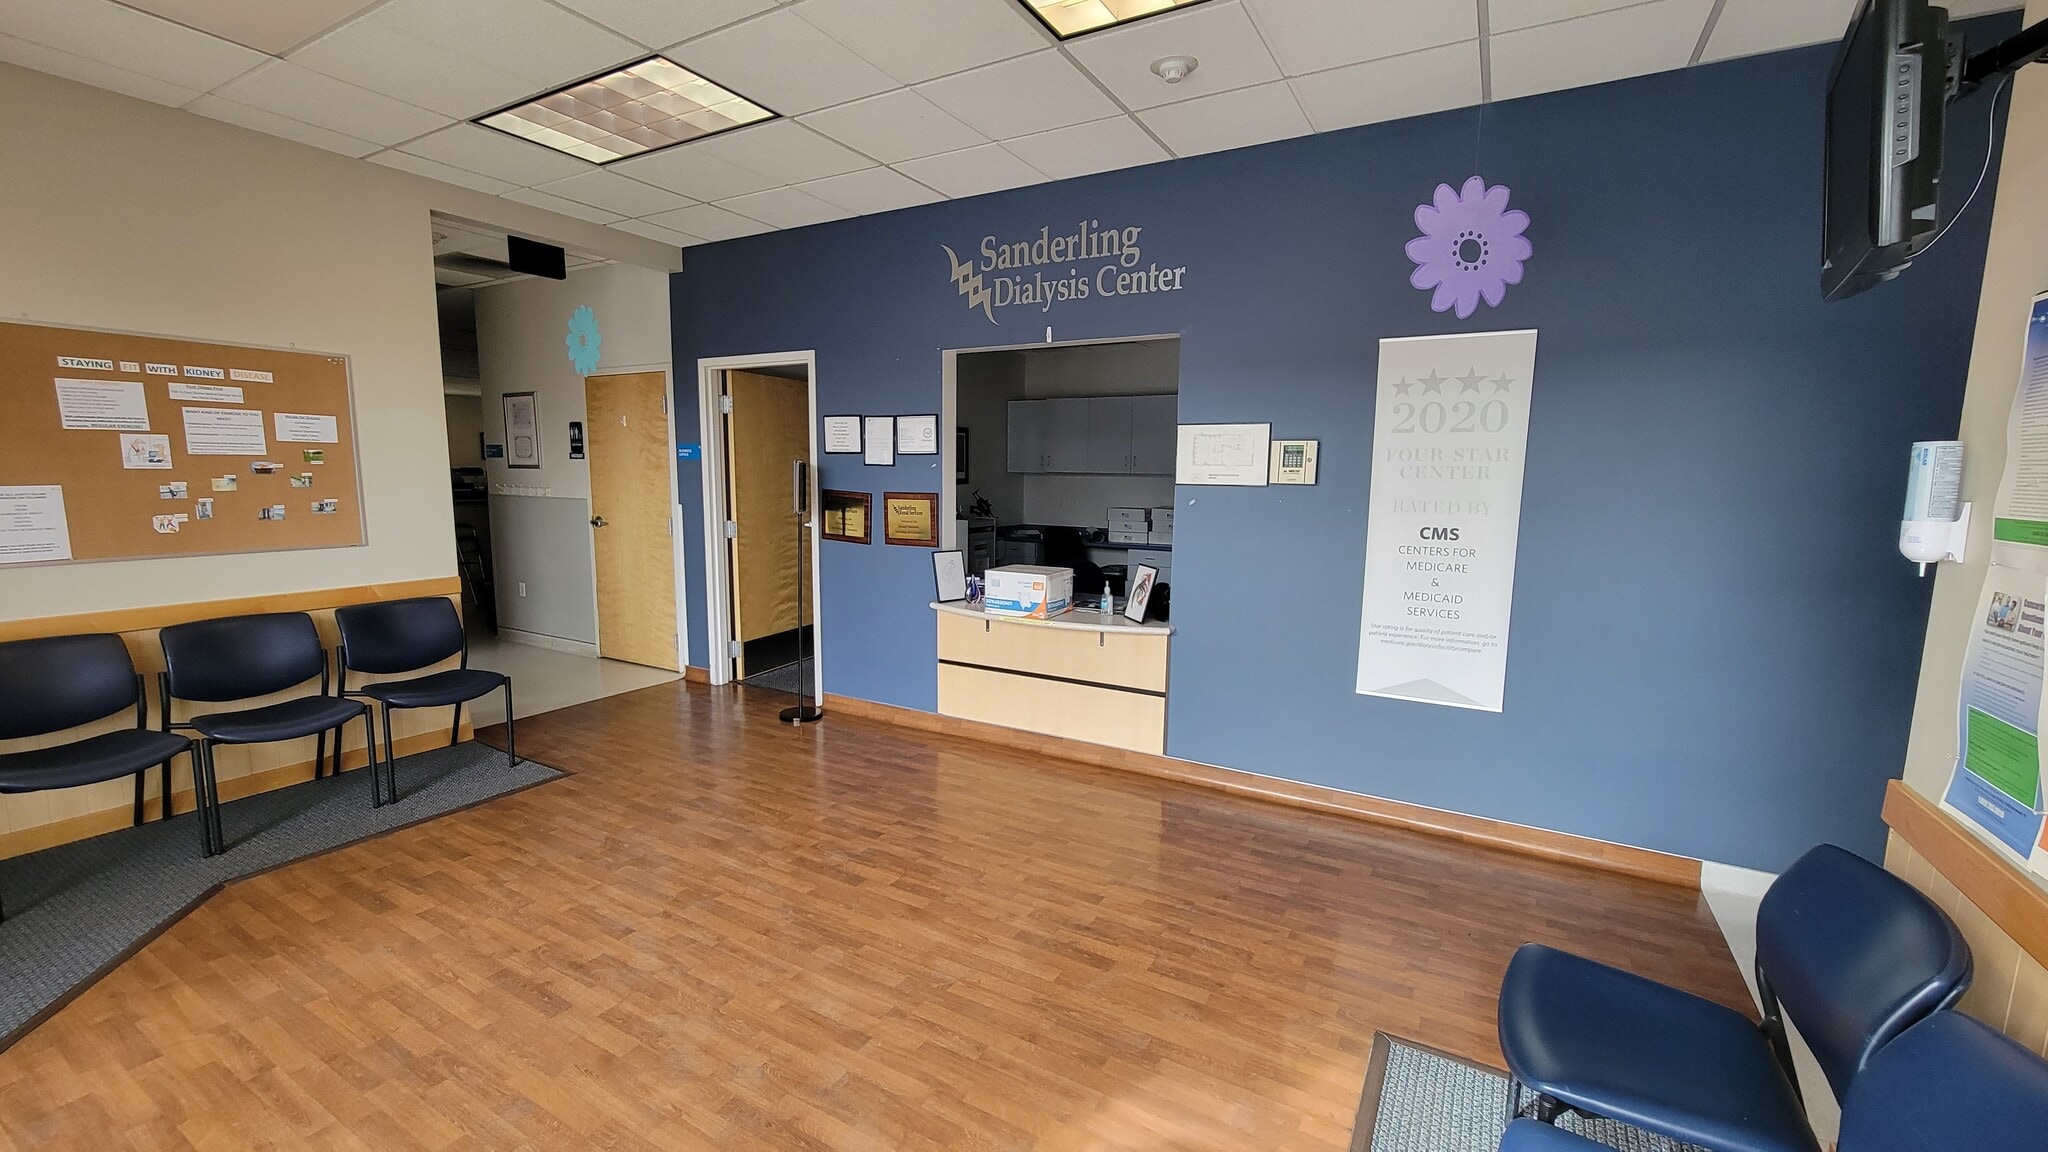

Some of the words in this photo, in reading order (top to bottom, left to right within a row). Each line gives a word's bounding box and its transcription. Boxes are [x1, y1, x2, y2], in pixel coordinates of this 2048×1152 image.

[980, 219, 1142, 272] Sanderling
[993, 268, 1090, 312] Dialysis
[1096, 262, 1186, 298] Center
[62, 358, 112, 369] STAYING
[148, 366, 176, 374] WITH
[186, 368, 221, 378] KIDNEY
[233, 371, 271, 381] DISEASE
[1391, 400, 1509, 433] 2020
[1399, 465, 1491, 480] CENTER
[1393, 499, 1461, 515] RATED
[1468, 501, 1490, 516] BY
[1419, 526, 1460, 541] CMS
[1398, 545, 1450, 557] CENTERS
[1453, 547, 1476, 558] FOR
[1406, 561, 1469, 574] MEDICARE
[1430, 577, 1440, 587] &
[1403, 591, 1463, 605] MEDICAID
[1406, 606, 1460, 620] SERVICES
